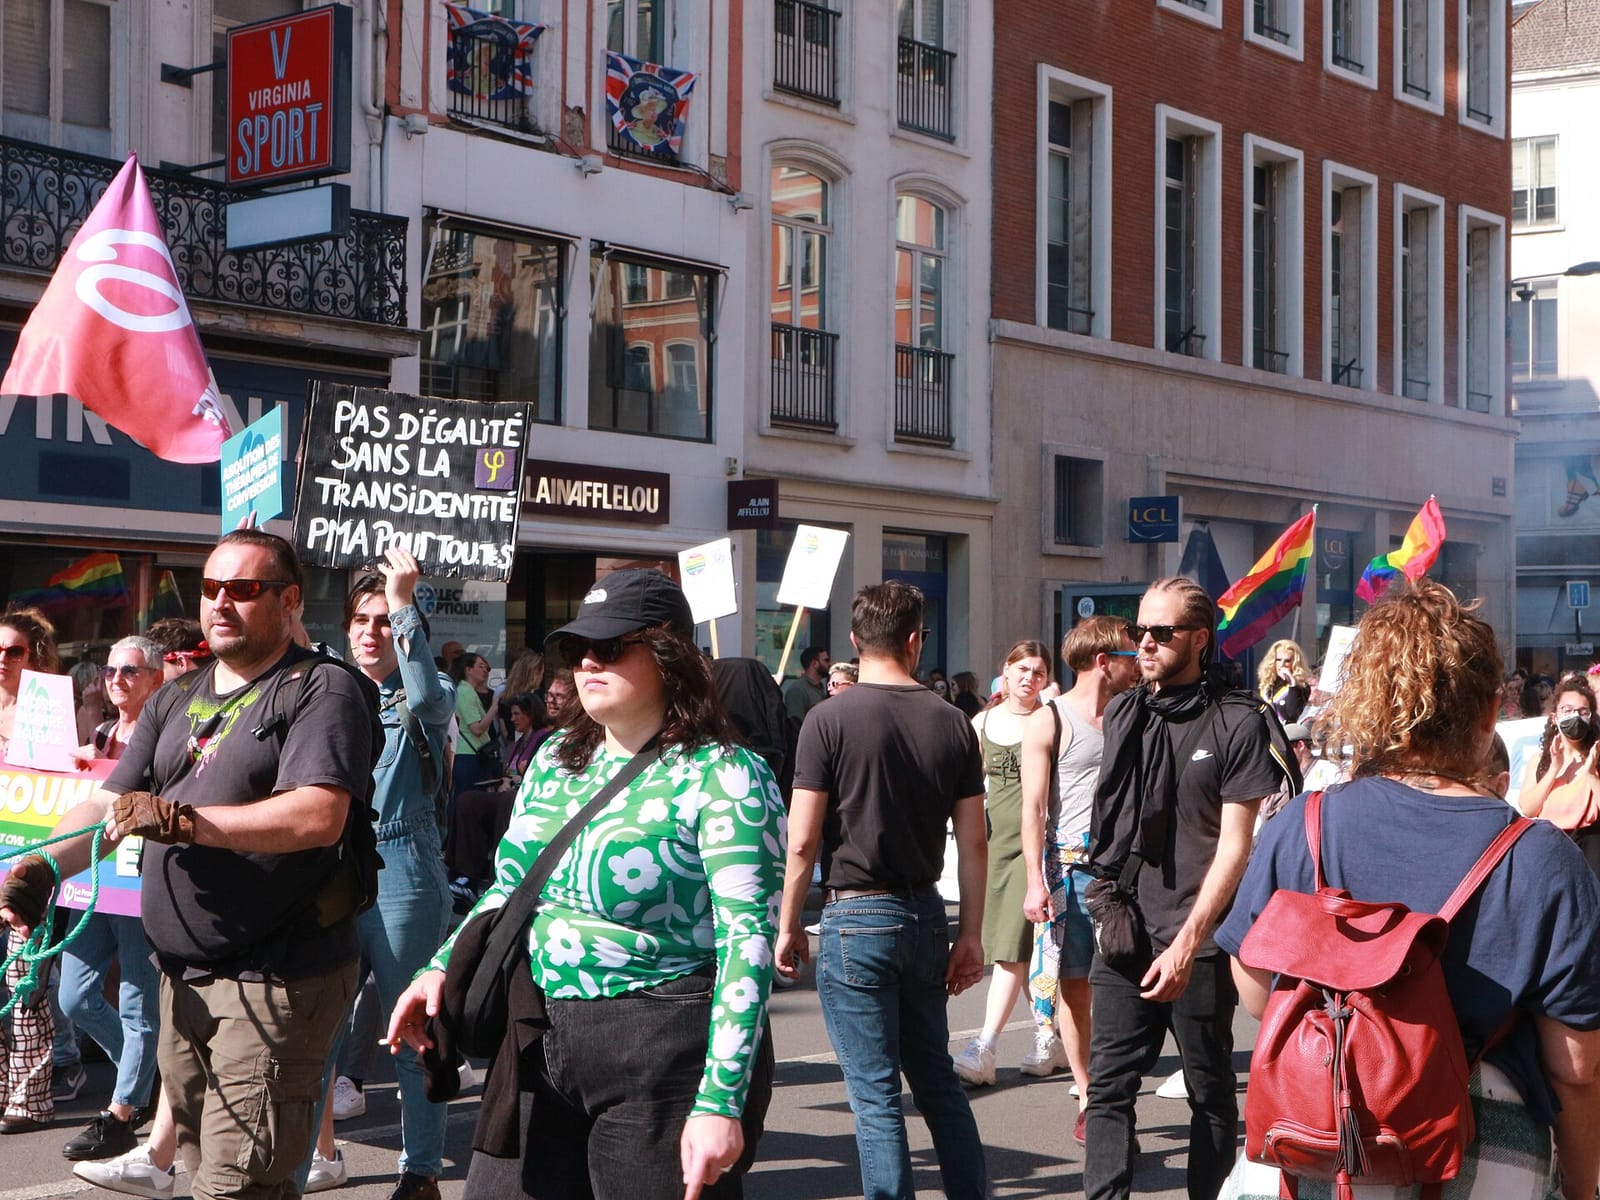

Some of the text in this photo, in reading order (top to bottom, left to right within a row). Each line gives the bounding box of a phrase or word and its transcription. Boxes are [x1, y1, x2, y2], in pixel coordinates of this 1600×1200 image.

[269, 26, 292, 80] V
[248, 79, 312, 112] VIRGINIA
[237, 102, 324, 175] SPORT
[334, 400, 390, 439] PAS
[223, 433, 280, 482] ABOLITION DES
[268, 450, 279, 470] DE
[331, 436, 450, 478] SANS LA
[227, 469, 277, 512] CONVERSION
[749, 497, 770, 507] ALAIN
[737, 507, 770, 517] AFFLELOU
[1133, 507, 1173, 523] LCL
[307, 517, 369, 557] PMA
[1324, 539, 1345, 555] LCL
